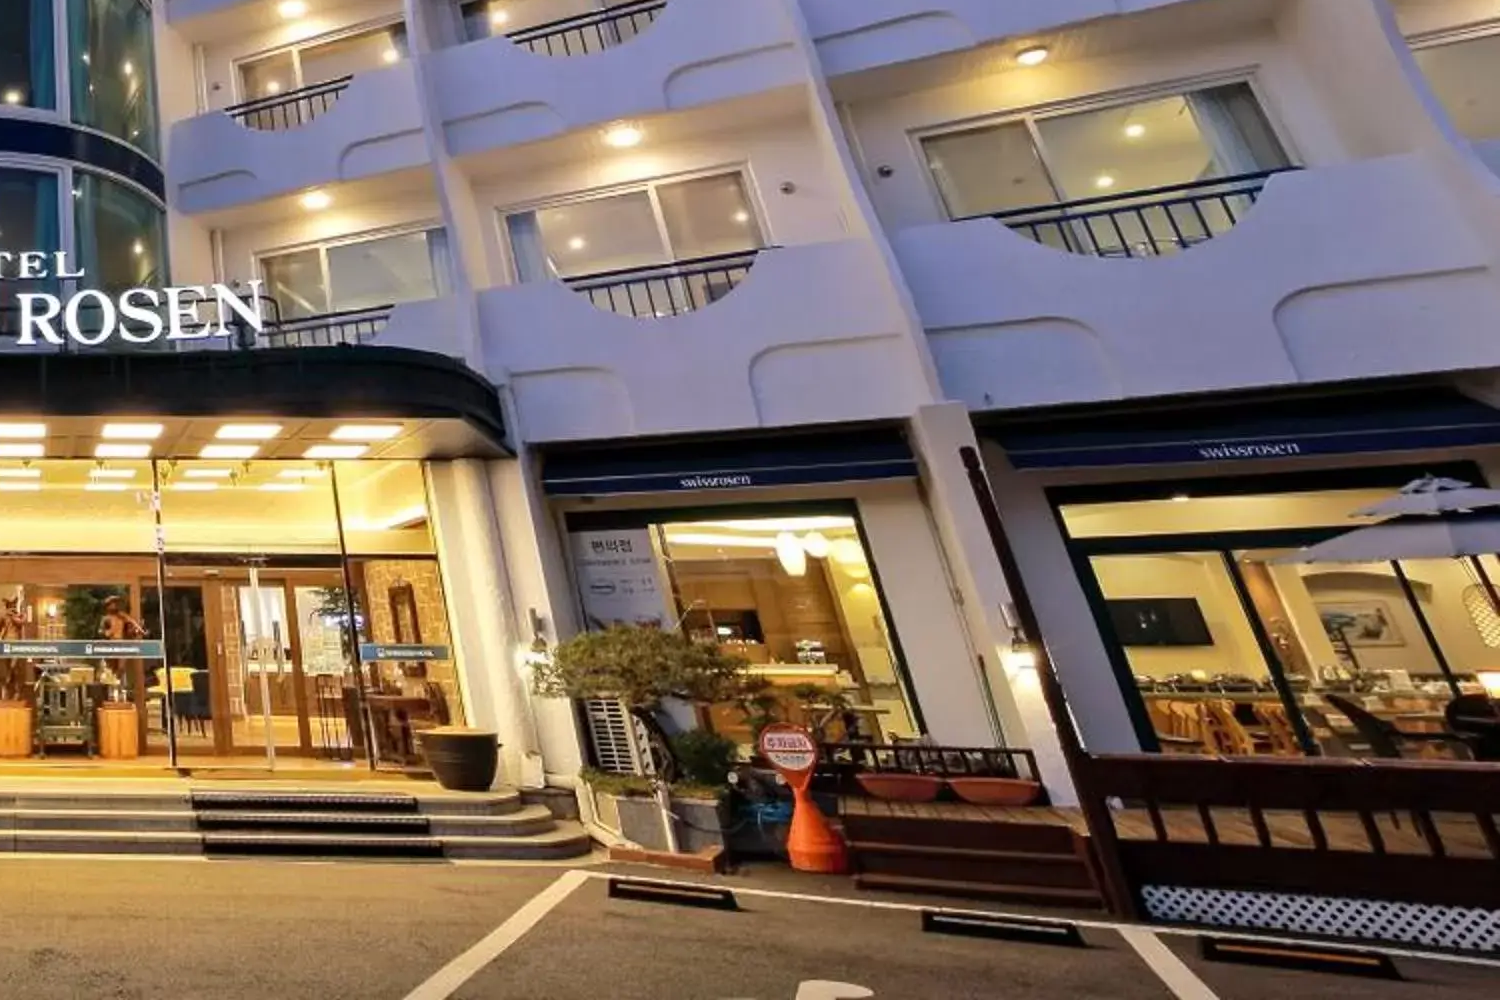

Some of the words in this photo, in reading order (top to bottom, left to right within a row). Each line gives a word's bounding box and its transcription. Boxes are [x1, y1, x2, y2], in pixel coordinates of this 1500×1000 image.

[17, 278, 264, 346] ROSEN
[1198, 442, 1301, 459] swissrosen
[679, 474, 752, 488] swissrosen
